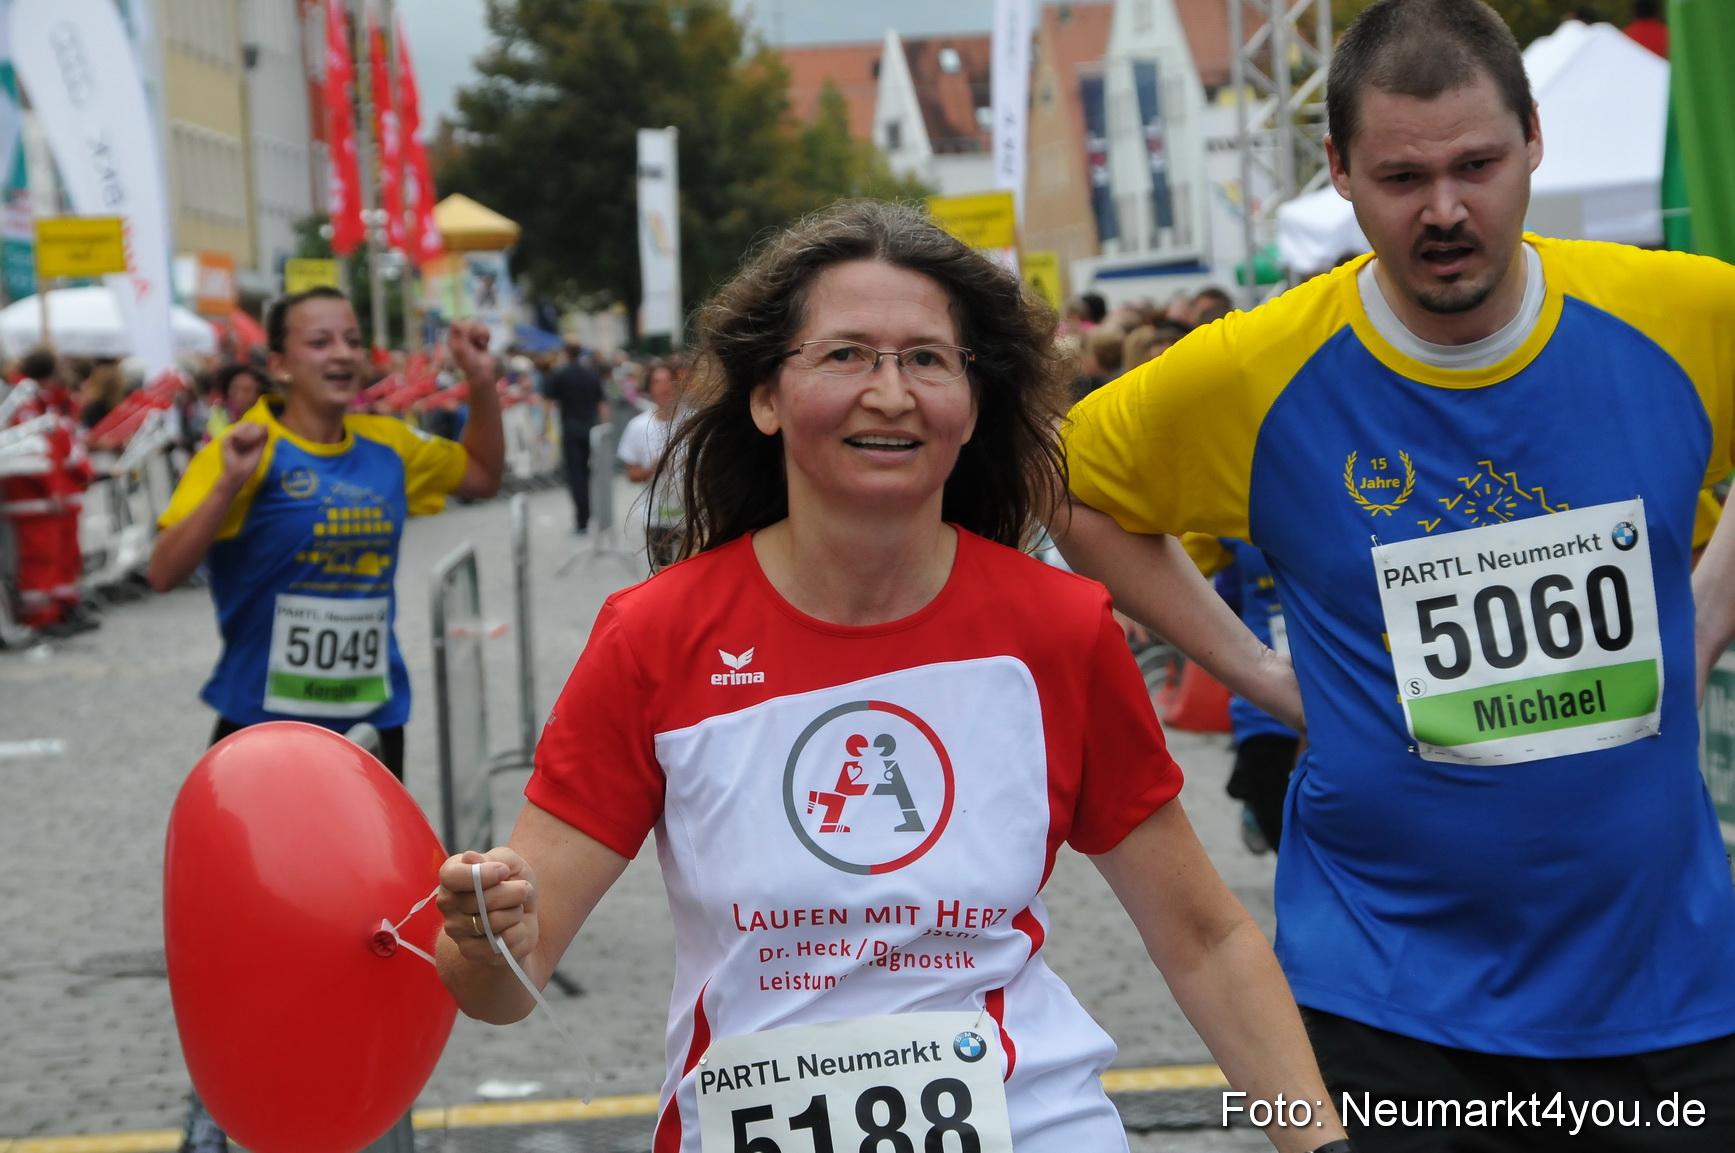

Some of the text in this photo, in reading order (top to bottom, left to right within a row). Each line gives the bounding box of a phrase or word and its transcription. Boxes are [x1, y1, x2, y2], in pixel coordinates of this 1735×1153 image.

[1360, 476, 1400, 489] Jahre
[1370, 457, 1387, 470] 15
[1383, 533, 1603, 590] PARTL Neumarkt
[1415, 564, 1635, 681] 5060
[285, 625, 380, 671] 5049
[711, 670, 765, 685] erima
[1473, 680, 1607, 732] Michael
[732, 899, 1008, 932] LAUFEN MIT HERZ
[759, 947, 790, 963] Dr.
[700, 1040, 943, 1095] PARTL Neumarkt
[731, 1077, 983, 1153] 5188
